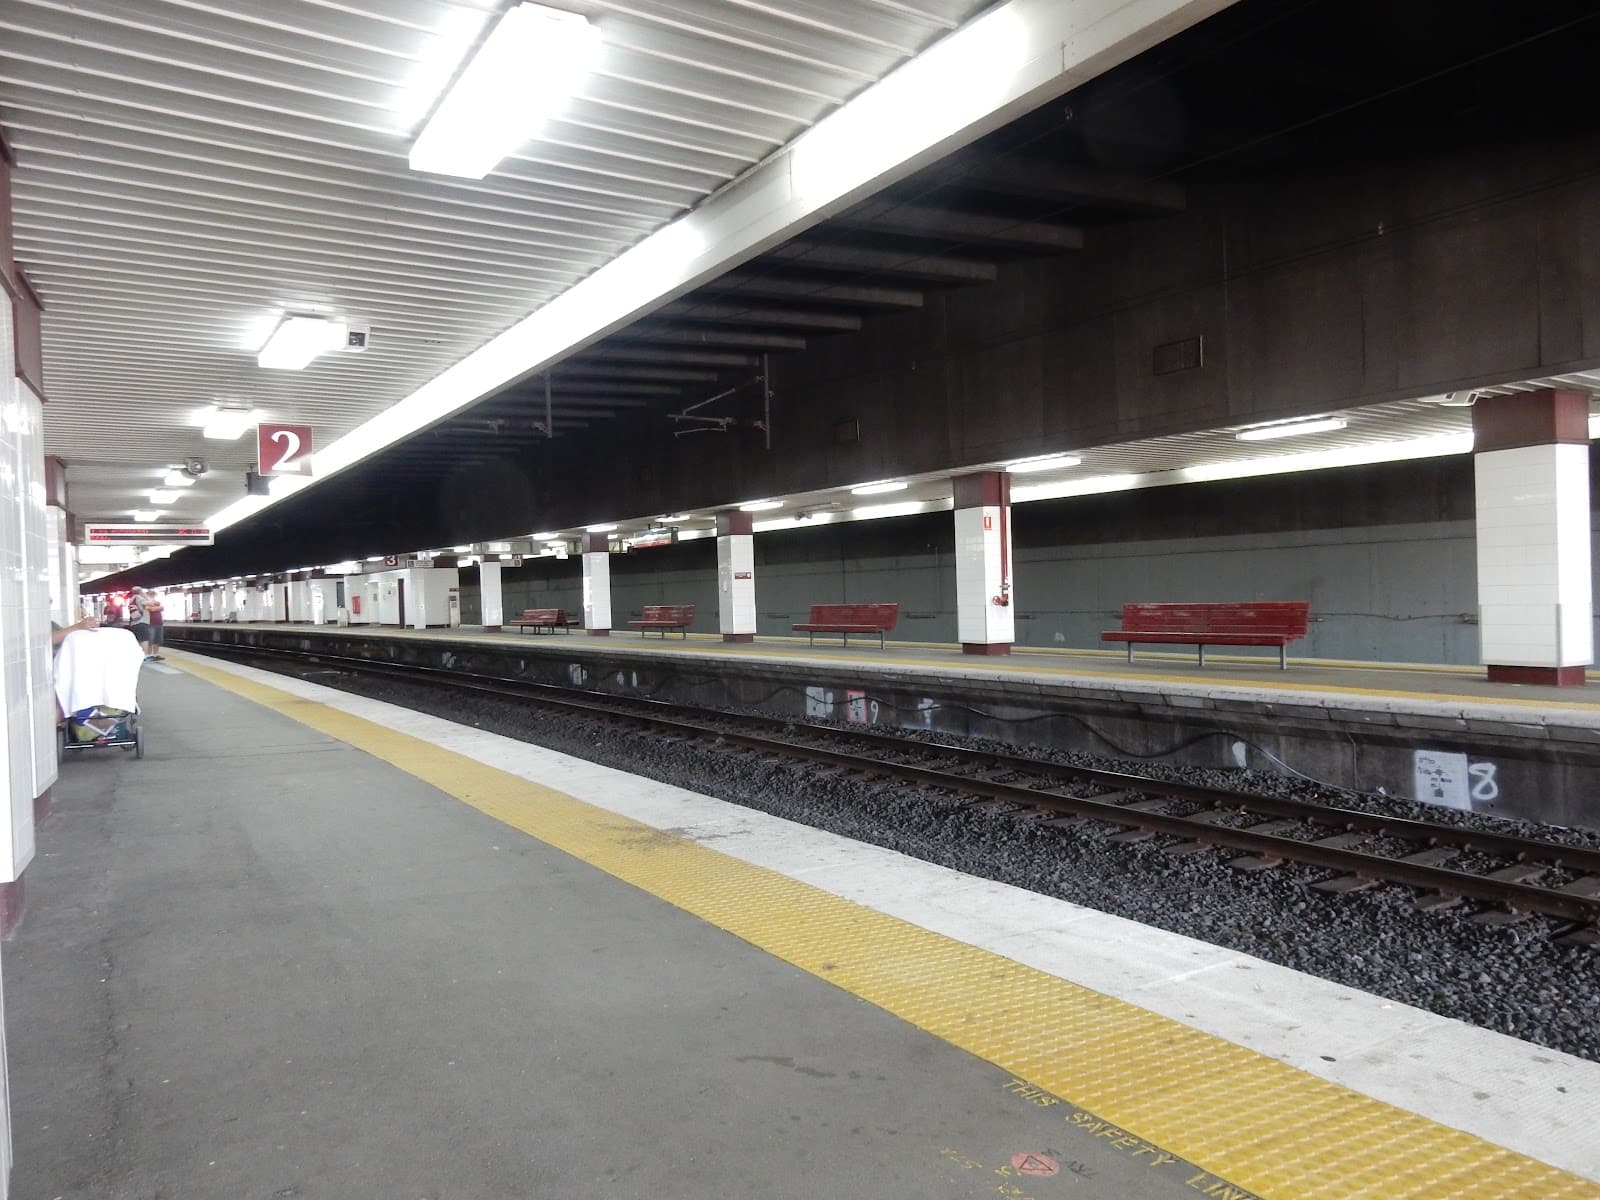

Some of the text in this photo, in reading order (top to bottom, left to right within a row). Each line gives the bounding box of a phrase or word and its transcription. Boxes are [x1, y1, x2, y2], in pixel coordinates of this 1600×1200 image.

[271, 430, 301, 472] 2
[386, 555, 396, 566] 3
[1468, 762, 1499, 800] 8
[1003, 1079, 1253, 1200] THIS SAFETY LIN
